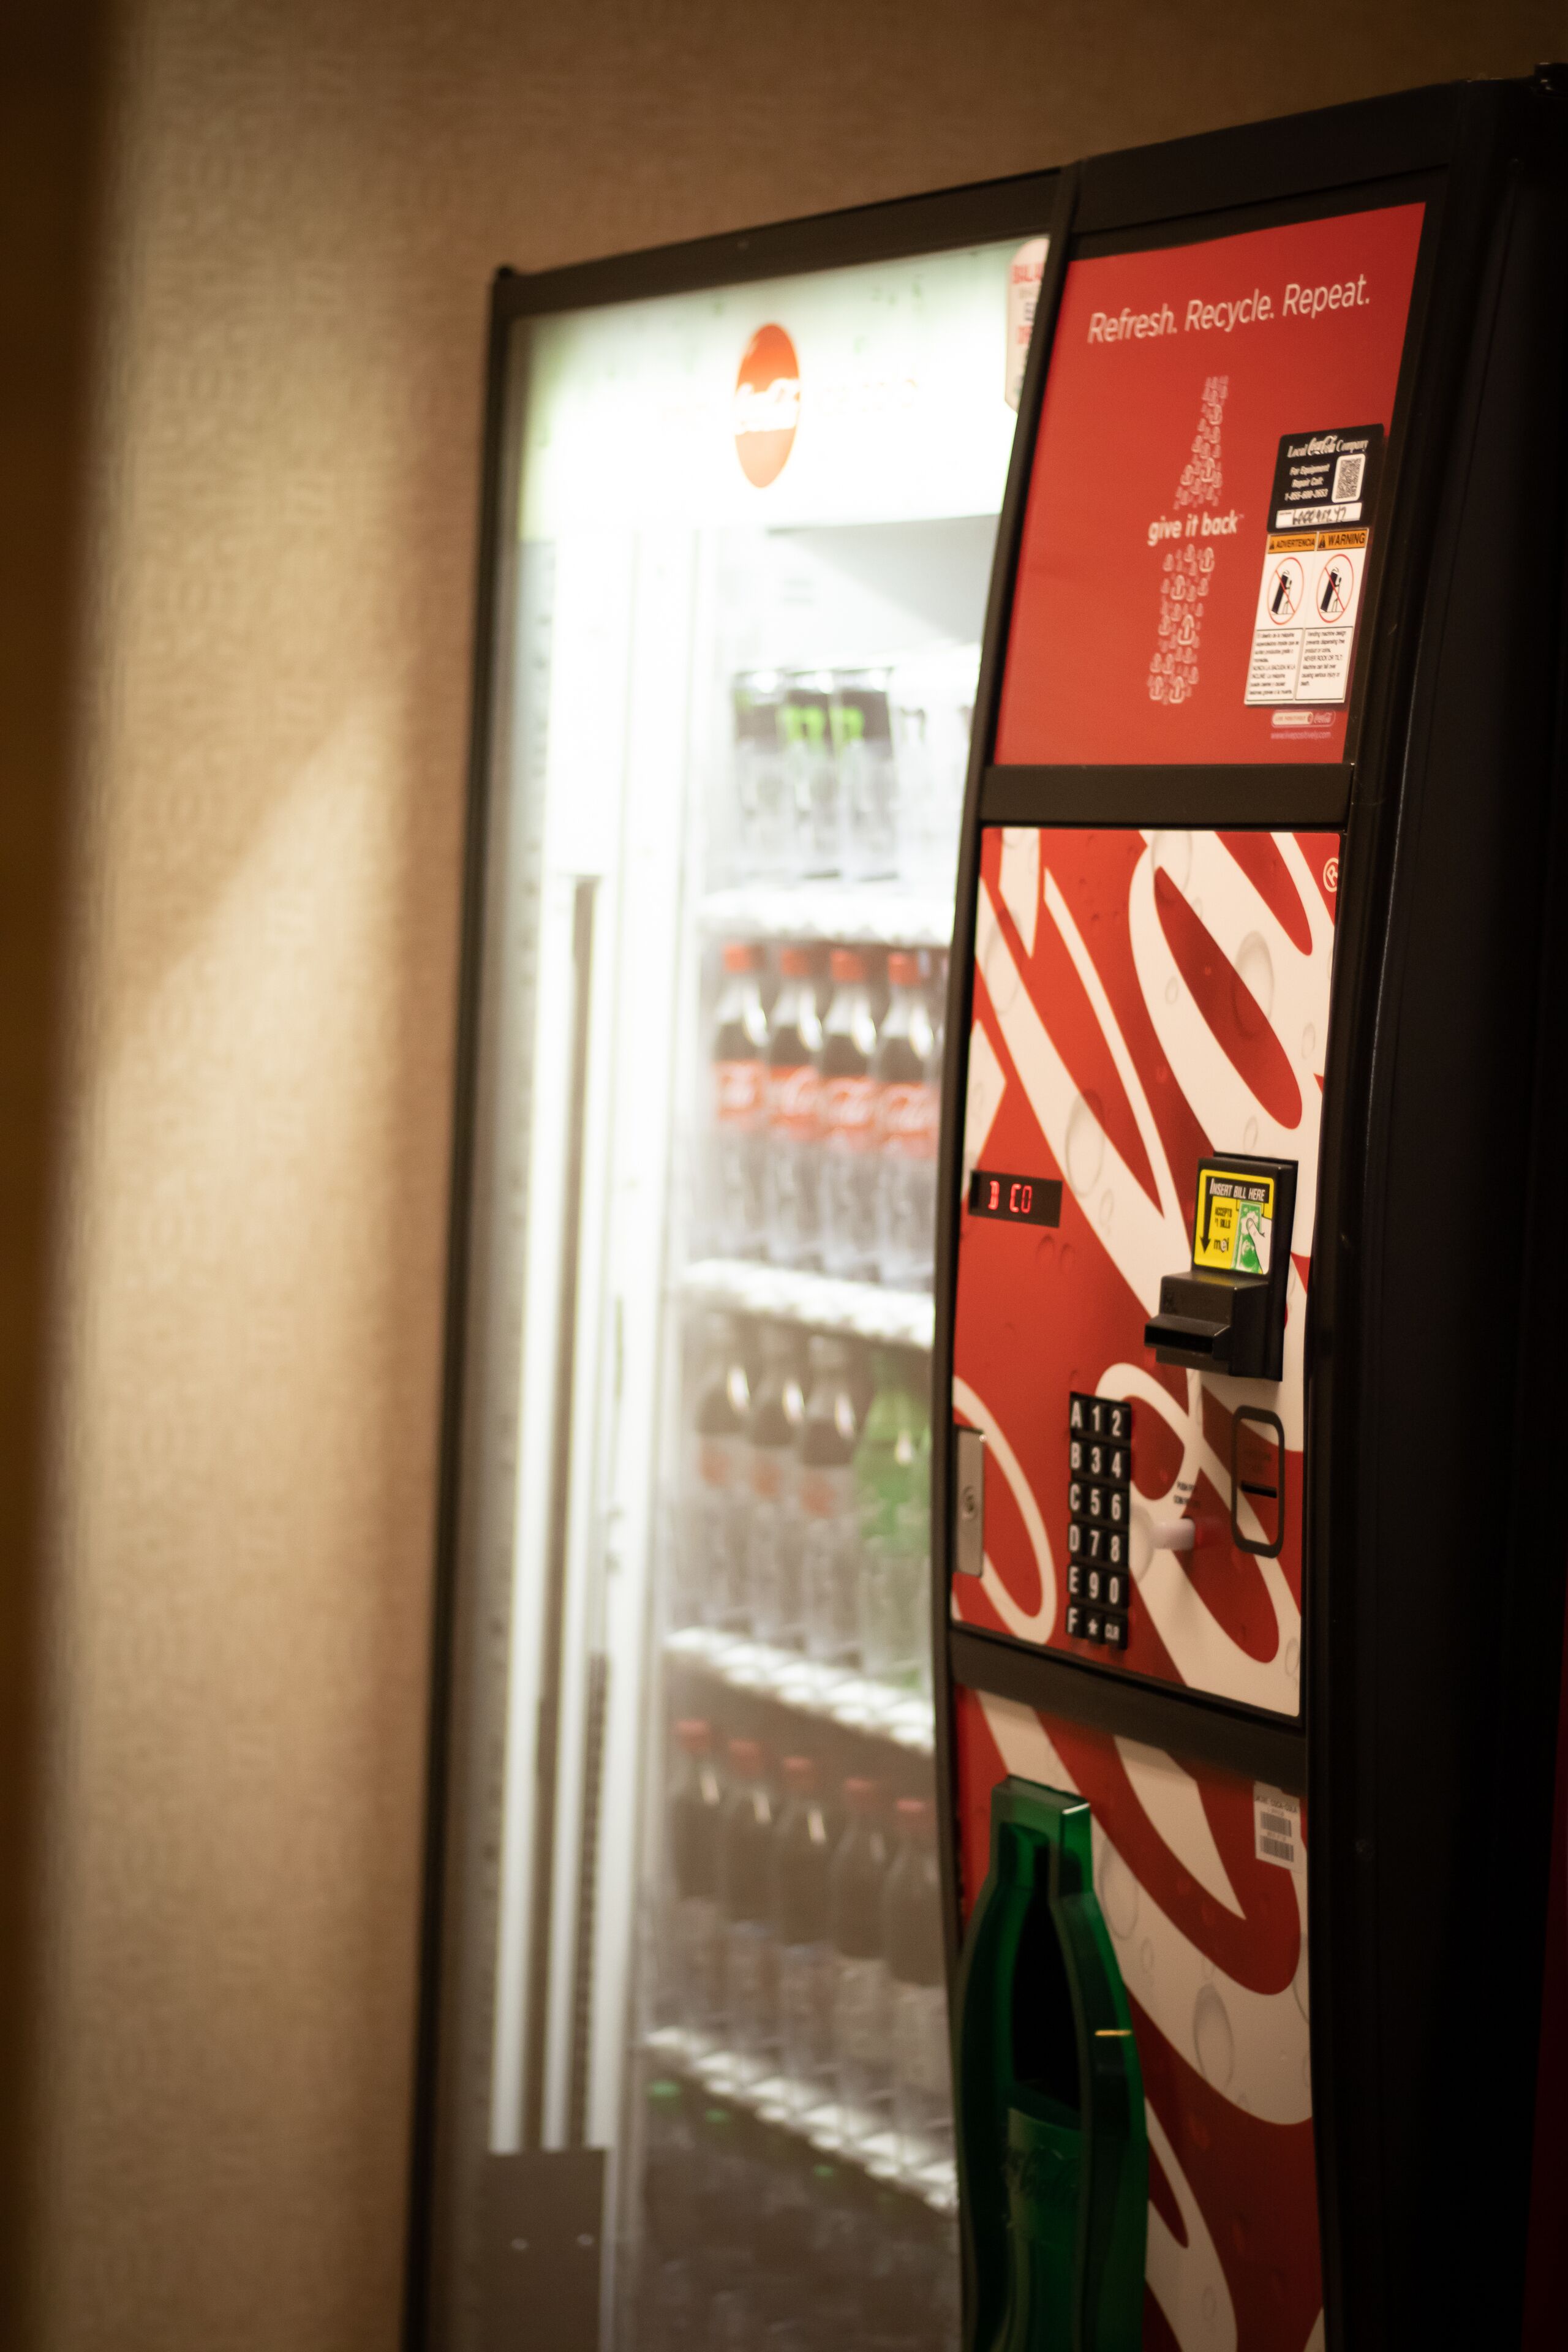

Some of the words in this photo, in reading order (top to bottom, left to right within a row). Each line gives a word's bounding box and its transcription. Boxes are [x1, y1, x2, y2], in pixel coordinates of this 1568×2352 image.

[1087, 302, 1177, 344] Refresh.
[1185, 288, 1275, 333] Recycle.
[1283, 273, 1370, 319] Repeat.
[1287, 443, 1308, 458] Local
[1336, 439, 1369, 453] Company
[1147, 515, 1183, 547] give
[1185, 513, 1199, 538] it
[1200, 509, 1238, 537] back
[1328, 532, 1366, 546] WARNING
[1209, 1178, 1233, 1197] INSERT
[1233, 1184, 1247, 1199] BILL
[1248, 1188, 1266, 1202] HERE
[1213, 1237, 1230, 1253] mei
[1071, 1400, 1082, 1428] A
[1092, 1405, 1101, 1432] 1
[1112, 1409, 1121, 1437] 2
[1071, 1442, 1082, 1469] B
[1091, 1446, 1101, 1475] 3
[1112, 1451, 1121, 1479] 4
[1070, 1483, 1081, 1511] C
[1090, 1488, 1101, 1516] 5
[1111, 1493, 1121, 1521] 6
[1069, 1524, 1080, 1552] D
[1089, 1529, 1100, 1557] 7
[1110, 1534, 1121, 1562] 8
[1068, 1566, 1080, 1594] E
[1088, 1571, 1099, 1600] 9
[1109, 1576, 1120, 1605] 0
[1067, 1606, 1079, 1635] F
